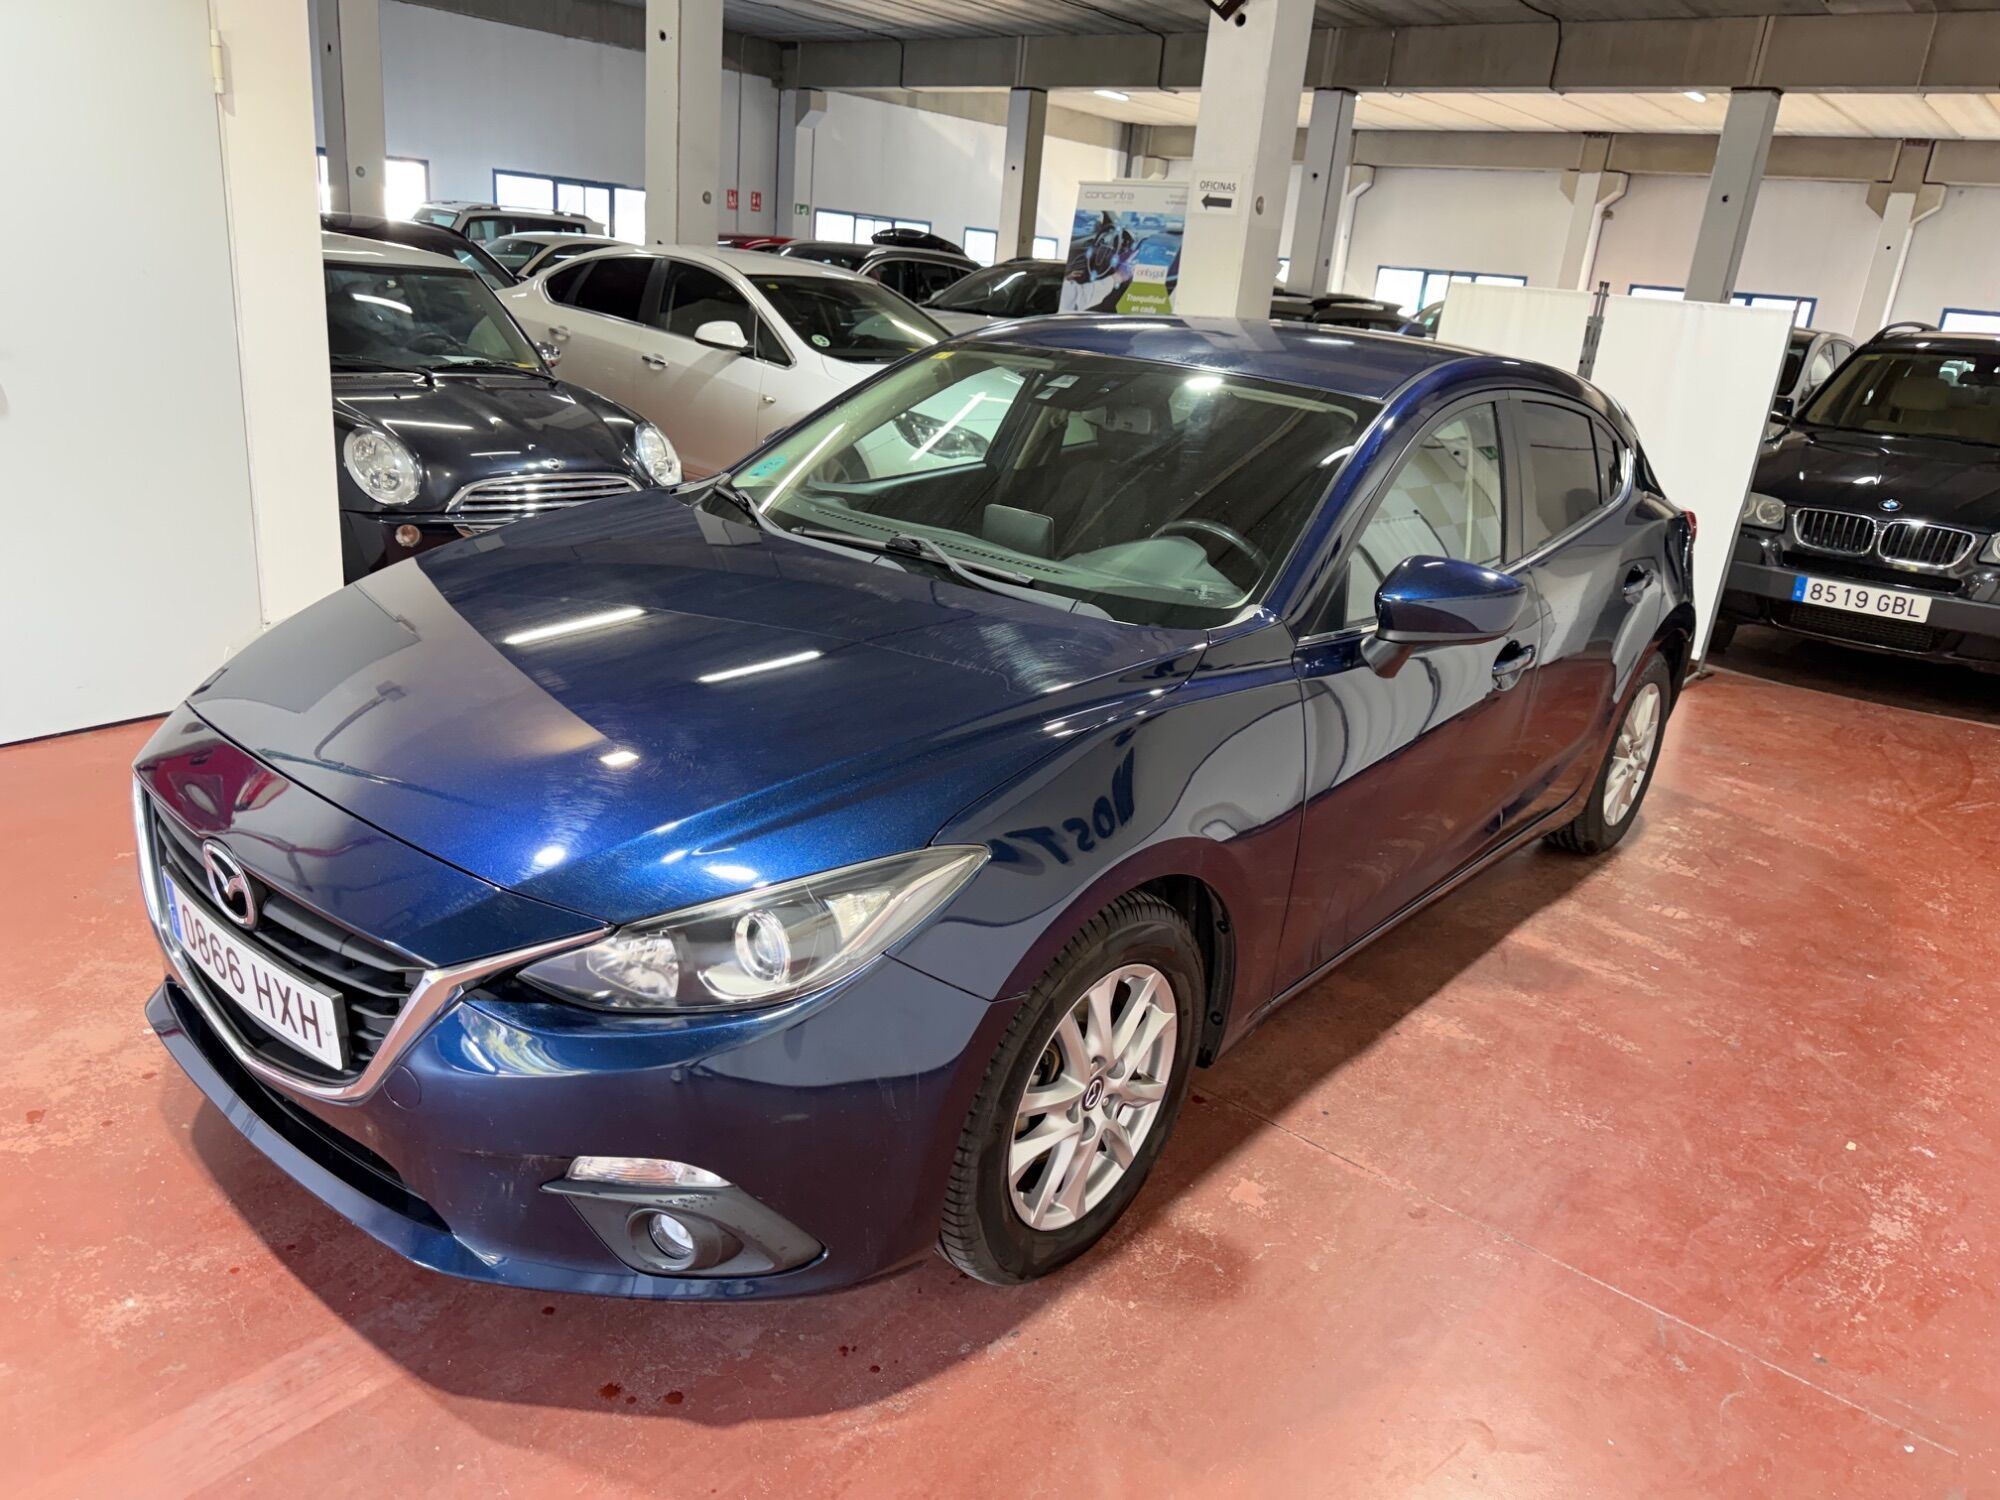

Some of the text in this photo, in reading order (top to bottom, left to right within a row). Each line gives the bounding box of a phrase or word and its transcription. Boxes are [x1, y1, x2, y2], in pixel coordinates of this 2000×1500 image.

[1200, 180, 1237, 191] OFICINAS
[1127, 294, 1166, 304] Tranquilidad
[1810, 583, 1919, 617] 8519 GBL
[183, 905, 322, 1048] 0866 HXH
